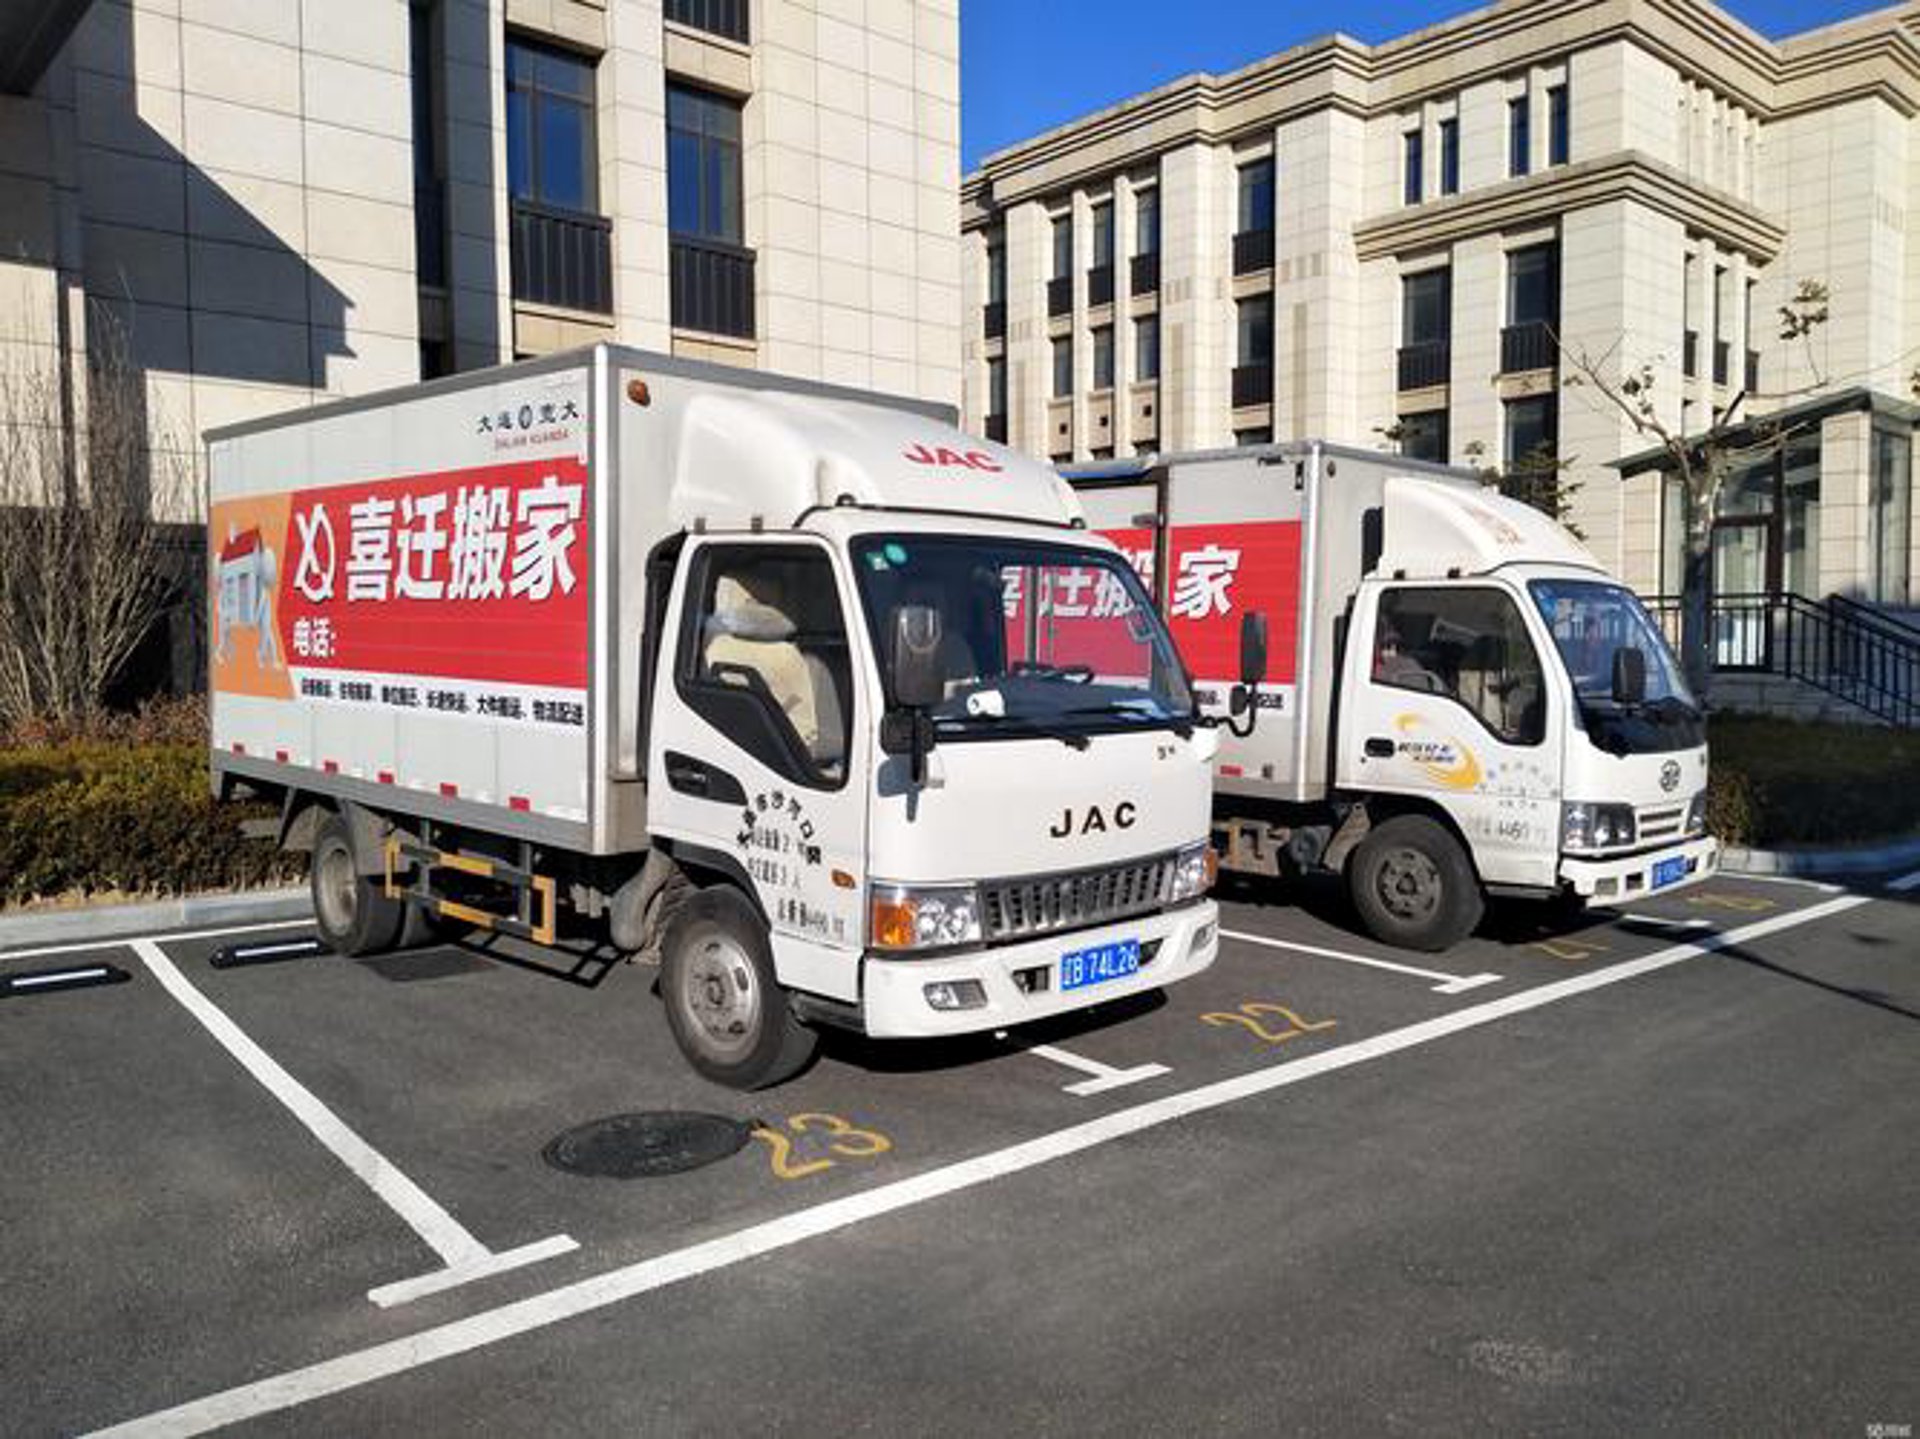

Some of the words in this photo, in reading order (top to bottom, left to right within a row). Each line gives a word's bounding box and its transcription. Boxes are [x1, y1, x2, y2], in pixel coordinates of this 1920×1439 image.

[905, 443, 1004, 473] JAC
[345, 476, 584, 603] 喜迁搬家
[1050, 802, 1136, 838] JAC
[751, 1113, 891, 1178] 23
